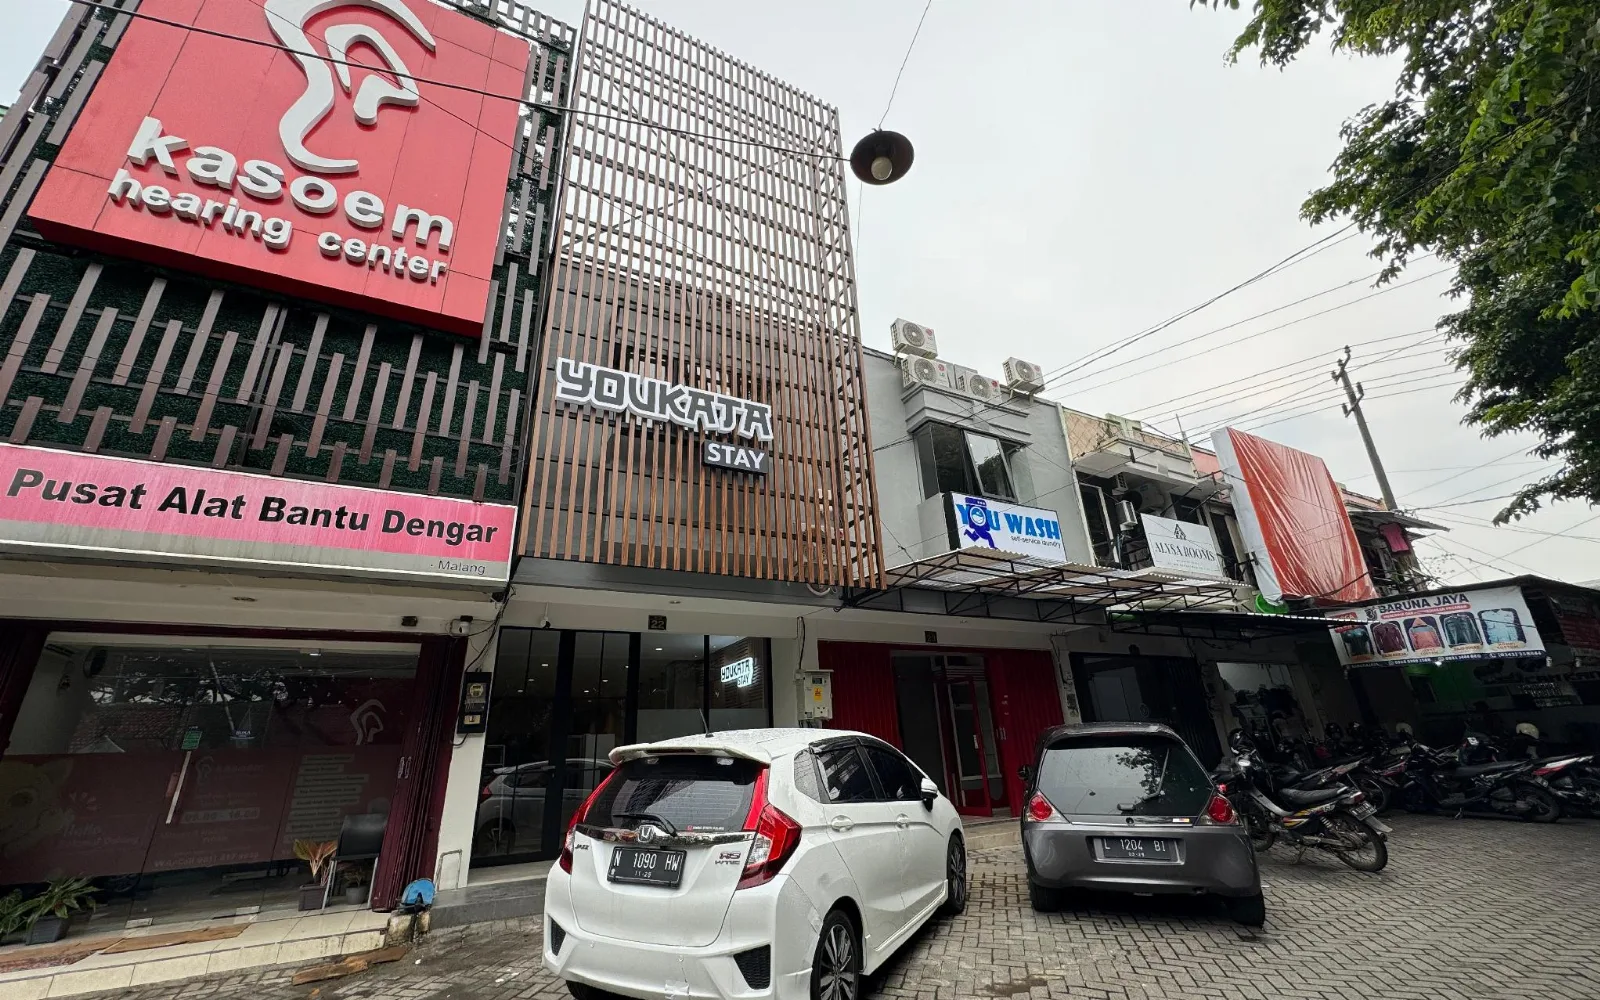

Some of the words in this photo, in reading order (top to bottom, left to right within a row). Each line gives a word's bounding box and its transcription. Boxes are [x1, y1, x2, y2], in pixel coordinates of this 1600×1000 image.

[127, 116, 455, 252] kasoem
[107, 169, 293, 249] hearing
[318, 231, 449, 283] center
[556, 357, 774, 441] YOUKATA
[707, 443, 765, 469] STAY
[7, 468, 147, 509] Pusat
[158, 488, 247, 520] Alat
[259, 496, 370, 532] Bantu
[382, 509, 499, 546] Dengar
[1003, 512, 1061, 540] WASH
[1155, 541, 1184, 557] ALYSA
[1183, 546, 1215, 562] ROOMS
[438, 560, 486, 576] Malang
[1379, 598, 1431, 613] BARUNA
[1433, 594, 1469, 606] JAYA
[721, 659, 750, 680] YOUKATA
[738, 674, 749, 686] STAY
[1104, 838, 1111, 850] L
[1120, 838, 1143, 850] 1204
[613, 850, 622, 867] N
[633, 852, 657, 869] 1090
[664, 854, 680, 871] HW
